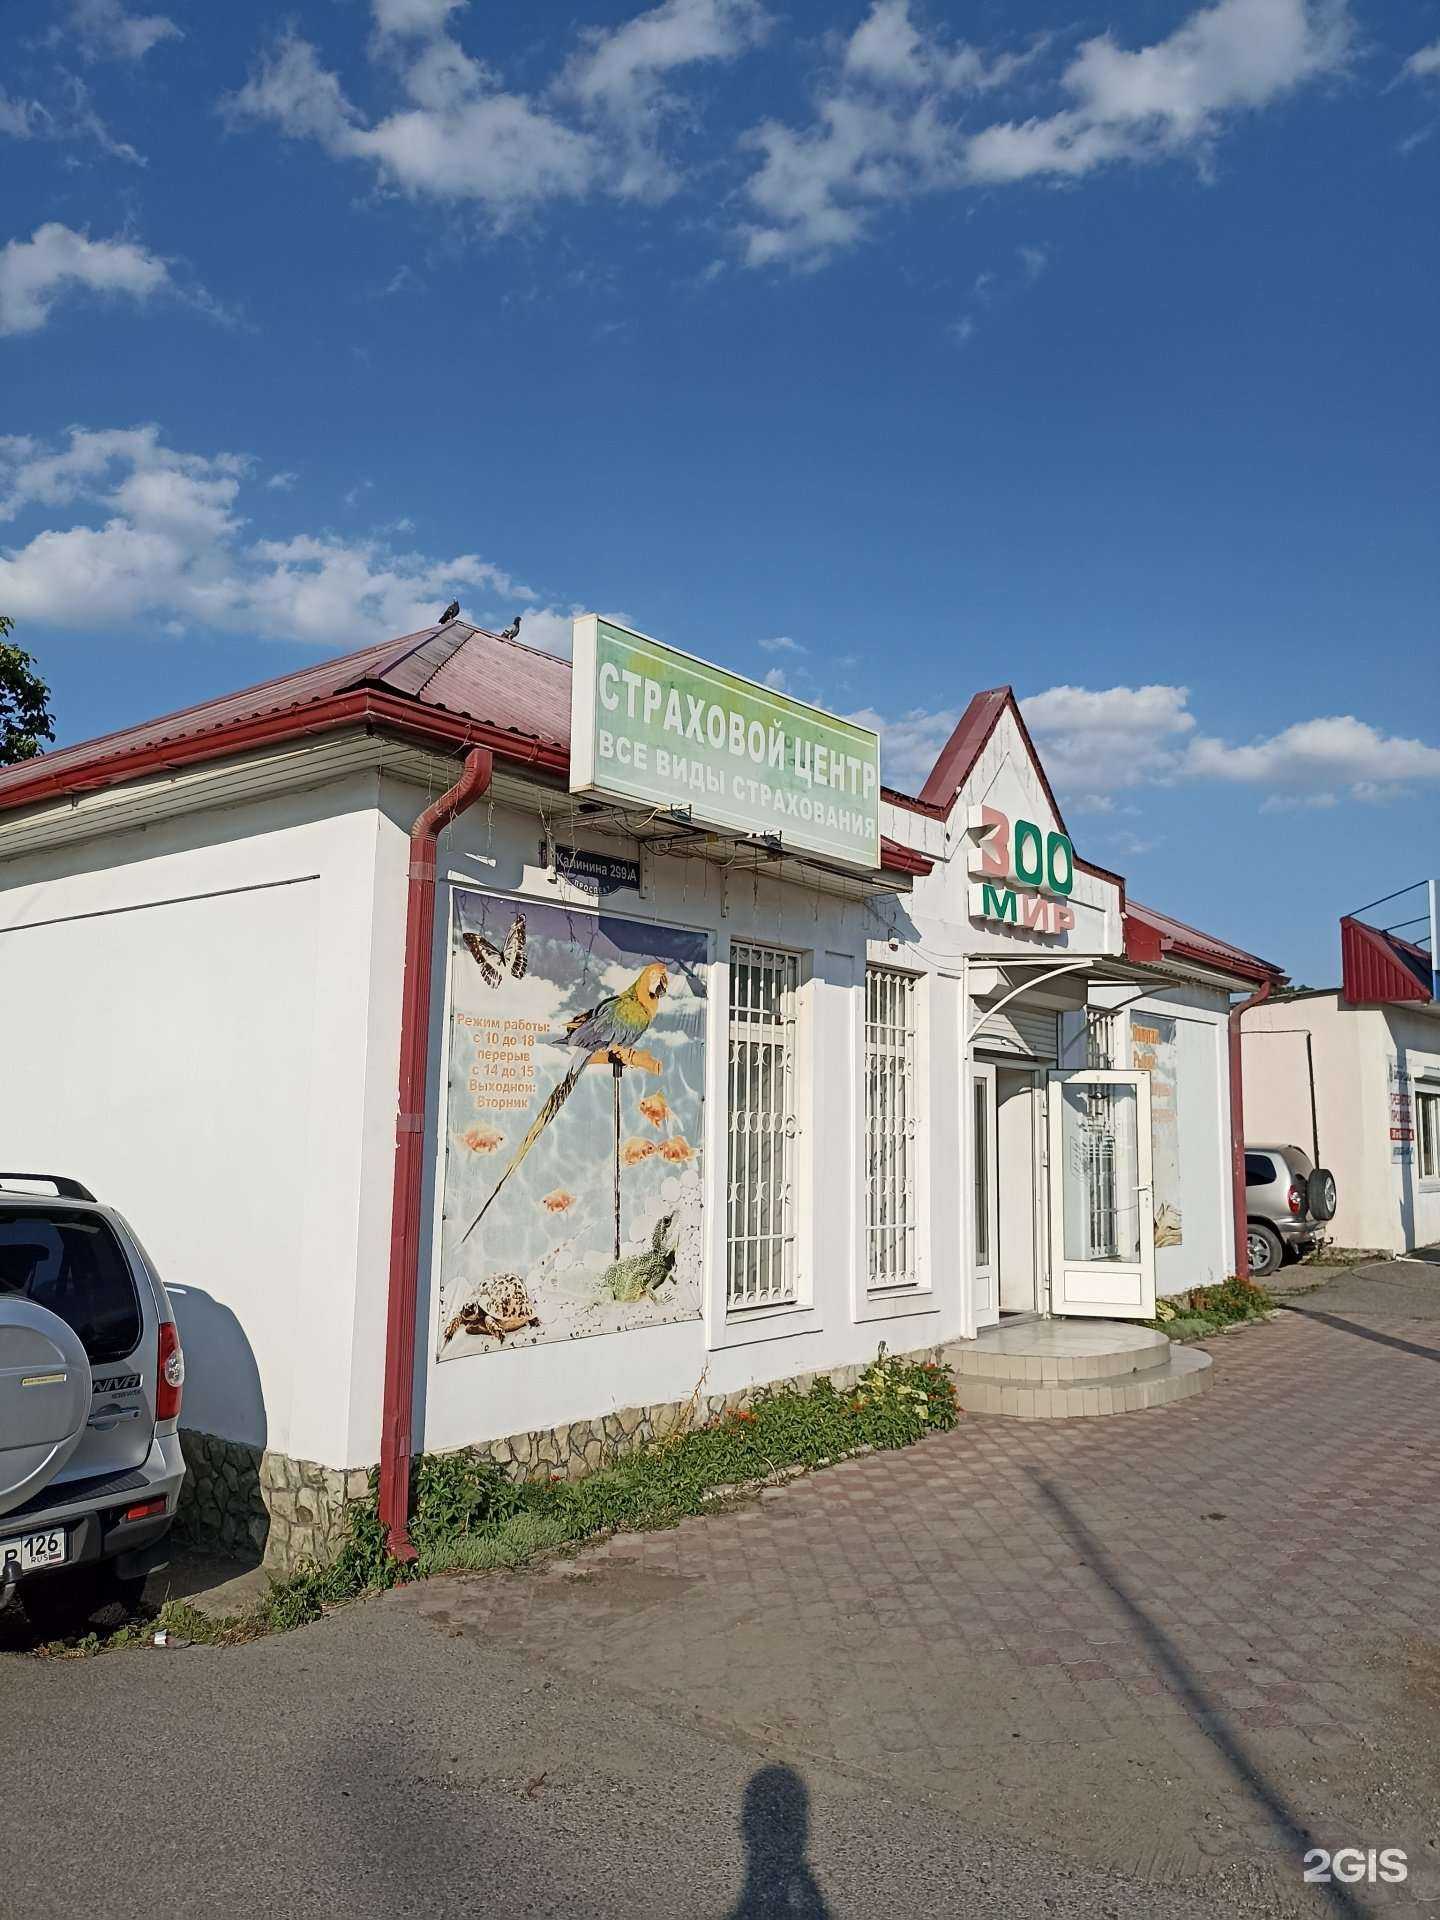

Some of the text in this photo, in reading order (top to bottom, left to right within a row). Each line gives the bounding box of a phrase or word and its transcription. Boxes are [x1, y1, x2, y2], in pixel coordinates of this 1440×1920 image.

[599, 662, 876, 800] СТРАХОВОЙ ЦЕНТР
[599, 728, 877, 840] ВСЕ ВИДЫ СТРАХОВАНИЯ
[976, 804, 1074, 896] ЗОО
[976, 883, 1075, 934] МИР
[456, 1012, 551, 1033] Режим работы:
[486, 1031, 500, 1045] 10
[502, 1036, 517, 1047] до
[521, 1034, 535, 1047] 18
[477, 1049, 530, 1063] перерыв
[485, 1063, 498, 1076] 14
[501, 1068, 516, 1079] до
[520, 1065, 534, 1077] 15
[475, 1096, 528, 1111] Вторник
[24, 1531, 59, 1557] 126
[30, 1553, 49, 1564] RUS
